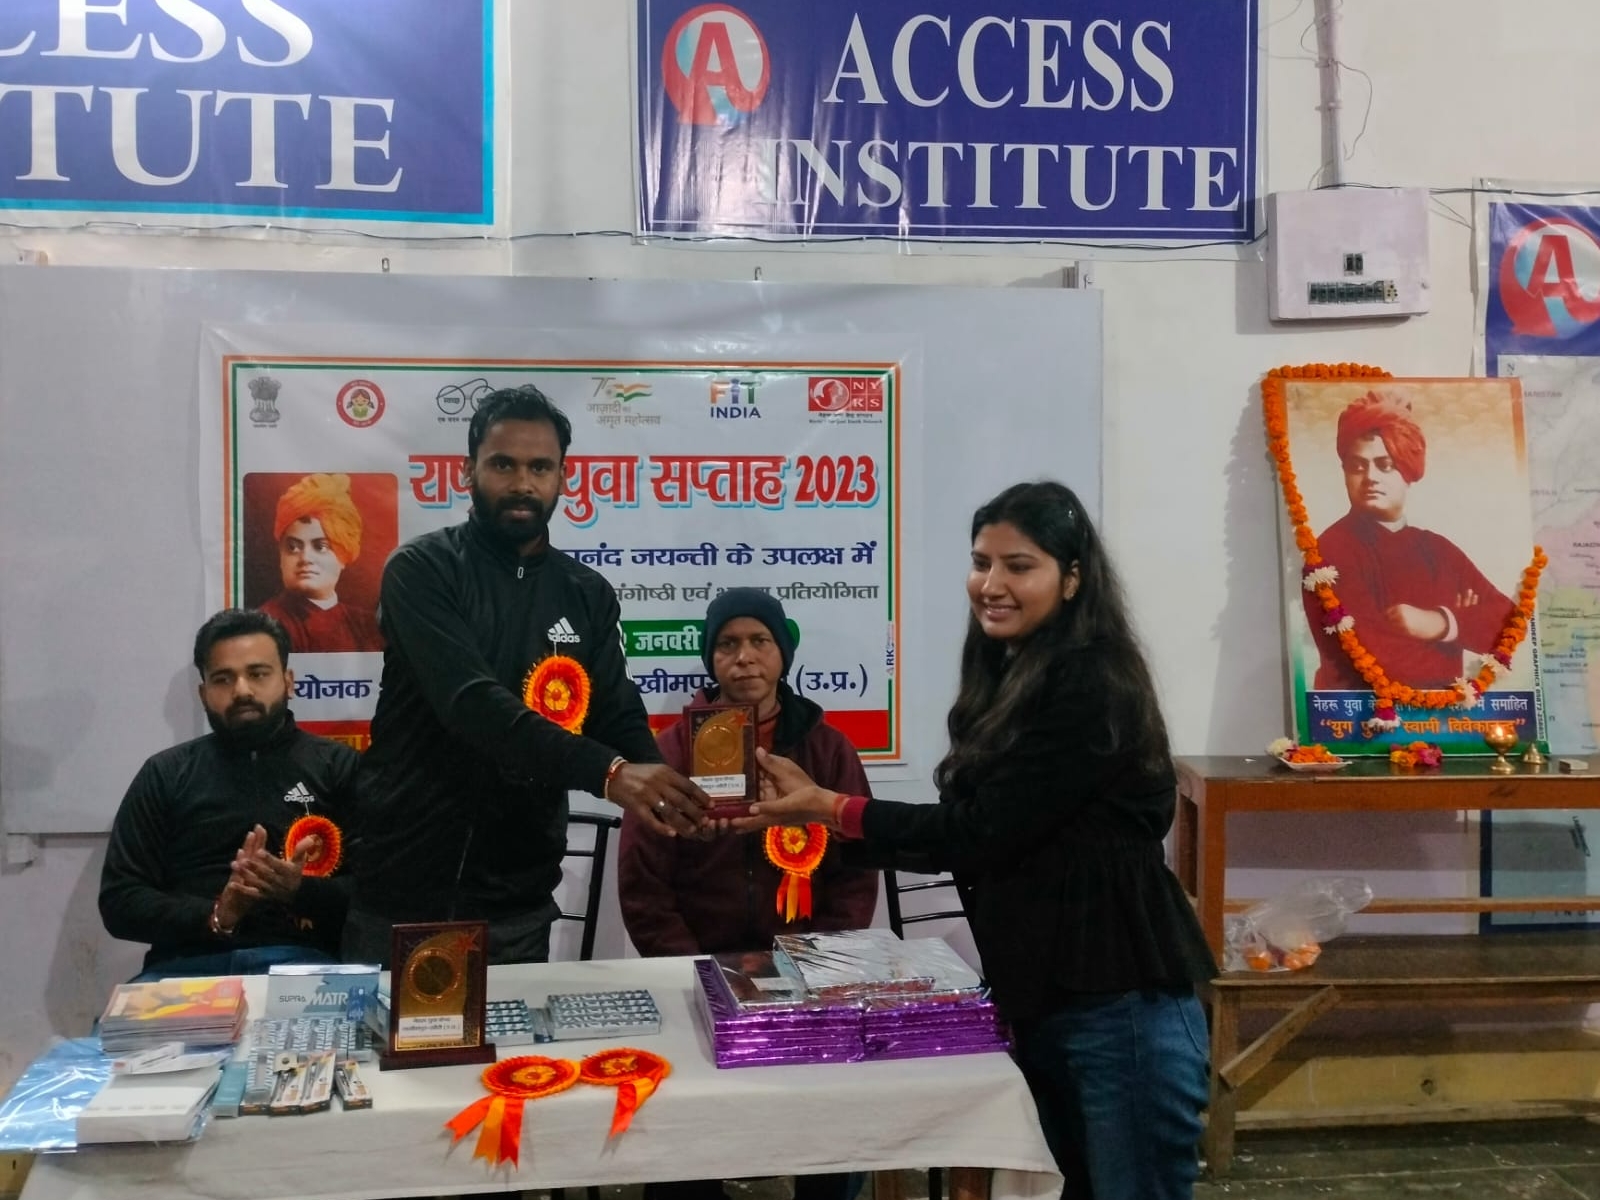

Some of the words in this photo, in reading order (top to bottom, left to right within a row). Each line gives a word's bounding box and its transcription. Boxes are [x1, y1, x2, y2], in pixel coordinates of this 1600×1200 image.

[0, 0, 313, 67] ESS
[823, 12, 1175, 112] ACCESS
[753, 138, 1240, 212] INSTITUTE
[710, 406, 761, 419] INDIA
[563, 455, 642, 525] युवा
[649, 455, 788, 507] सप्ताह
[795, 455, 878, 504] 2023
[631, 542, 718, 567] जयन्ती
[726, 542, 754, 566] के
[851, 540, 877, 565] में
[681, 582, 713, 601] एवं
[632, 625, 701, 651] जनवरी
[294, 675, 373, 700] योजक
[308, 991, 350, 1006] MATR
